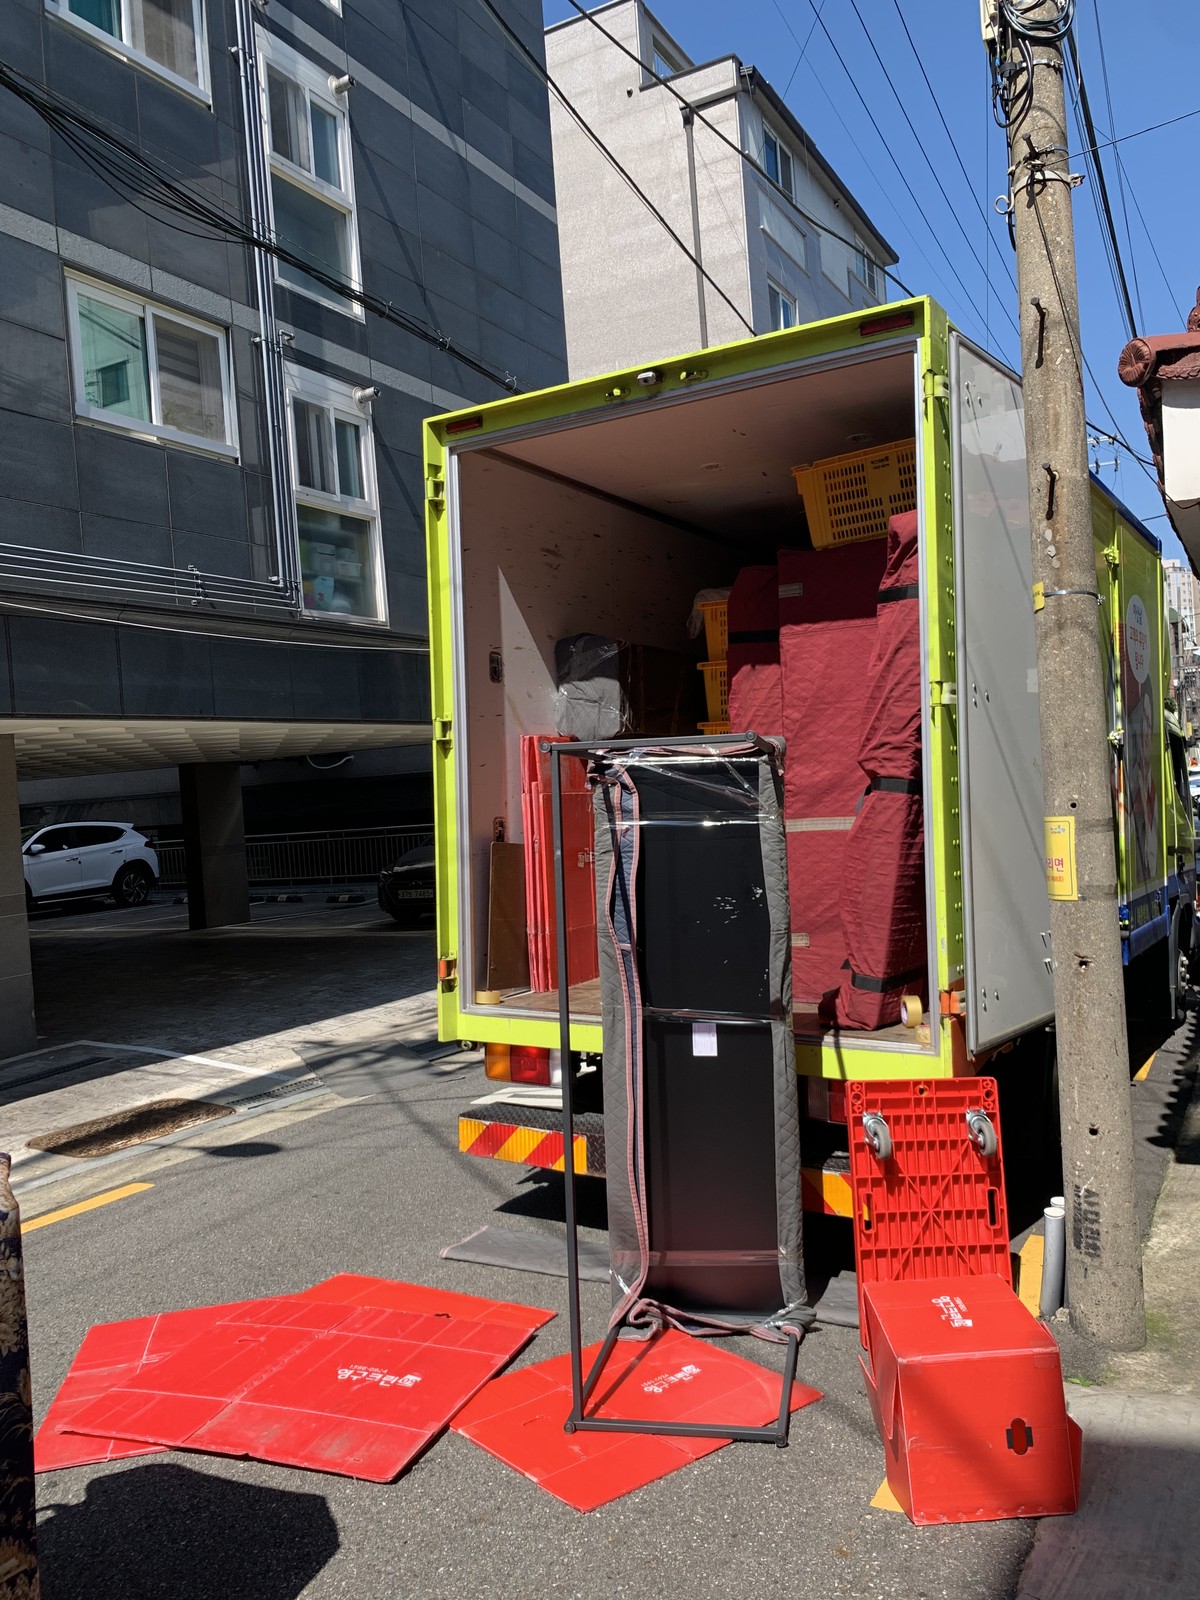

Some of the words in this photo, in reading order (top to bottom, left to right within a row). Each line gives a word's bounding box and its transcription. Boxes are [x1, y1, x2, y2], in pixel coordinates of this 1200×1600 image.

[1045, 857, 1064, 873] 리면
[931, 1295, 963, 1321] 영구크린
[337, 1368, 399, 1387] 영구크린
[643, 1371, 694, 1393] 영구크린
